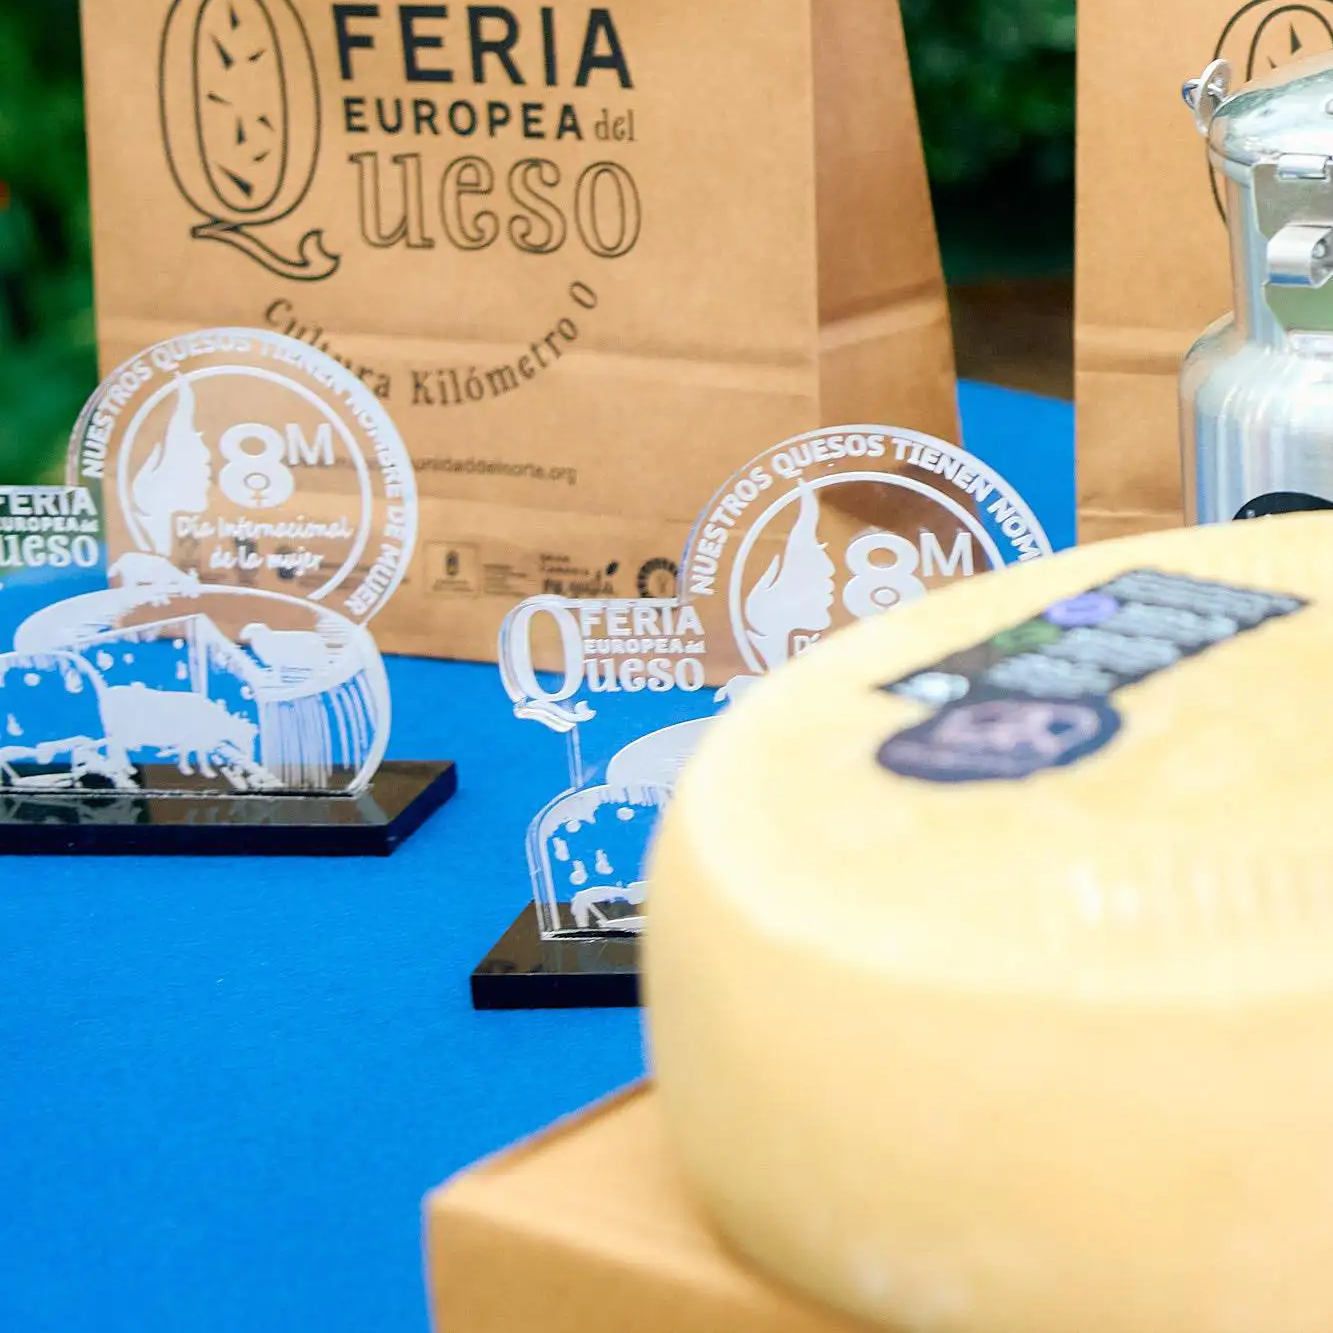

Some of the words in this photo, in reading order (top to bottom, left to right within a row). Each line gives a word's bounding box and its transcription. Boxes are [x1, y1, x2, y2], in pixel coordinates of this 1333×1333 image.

[331, 3, 635, 90] FERIA
[343, 96, 584, 142] EUROPEA
[594, 108, 636, 142] del
[410, 316, 580, 407] Kilómetro
[82, 358, 154, 479] NUESTROS
[0, 486, 98, 516] ERIA
[217, 422, 336, 509] 8M
[690, 467, 774, 597] NUESTROS
[771, 434, 887, 480] QUESOS
[890, 436, 996, 503] TIENEN
[986, 491, 1044, 562] NOM
[580, 605, 706, 637] FERIA
[583, 637, 684, 655] EUROPEA
